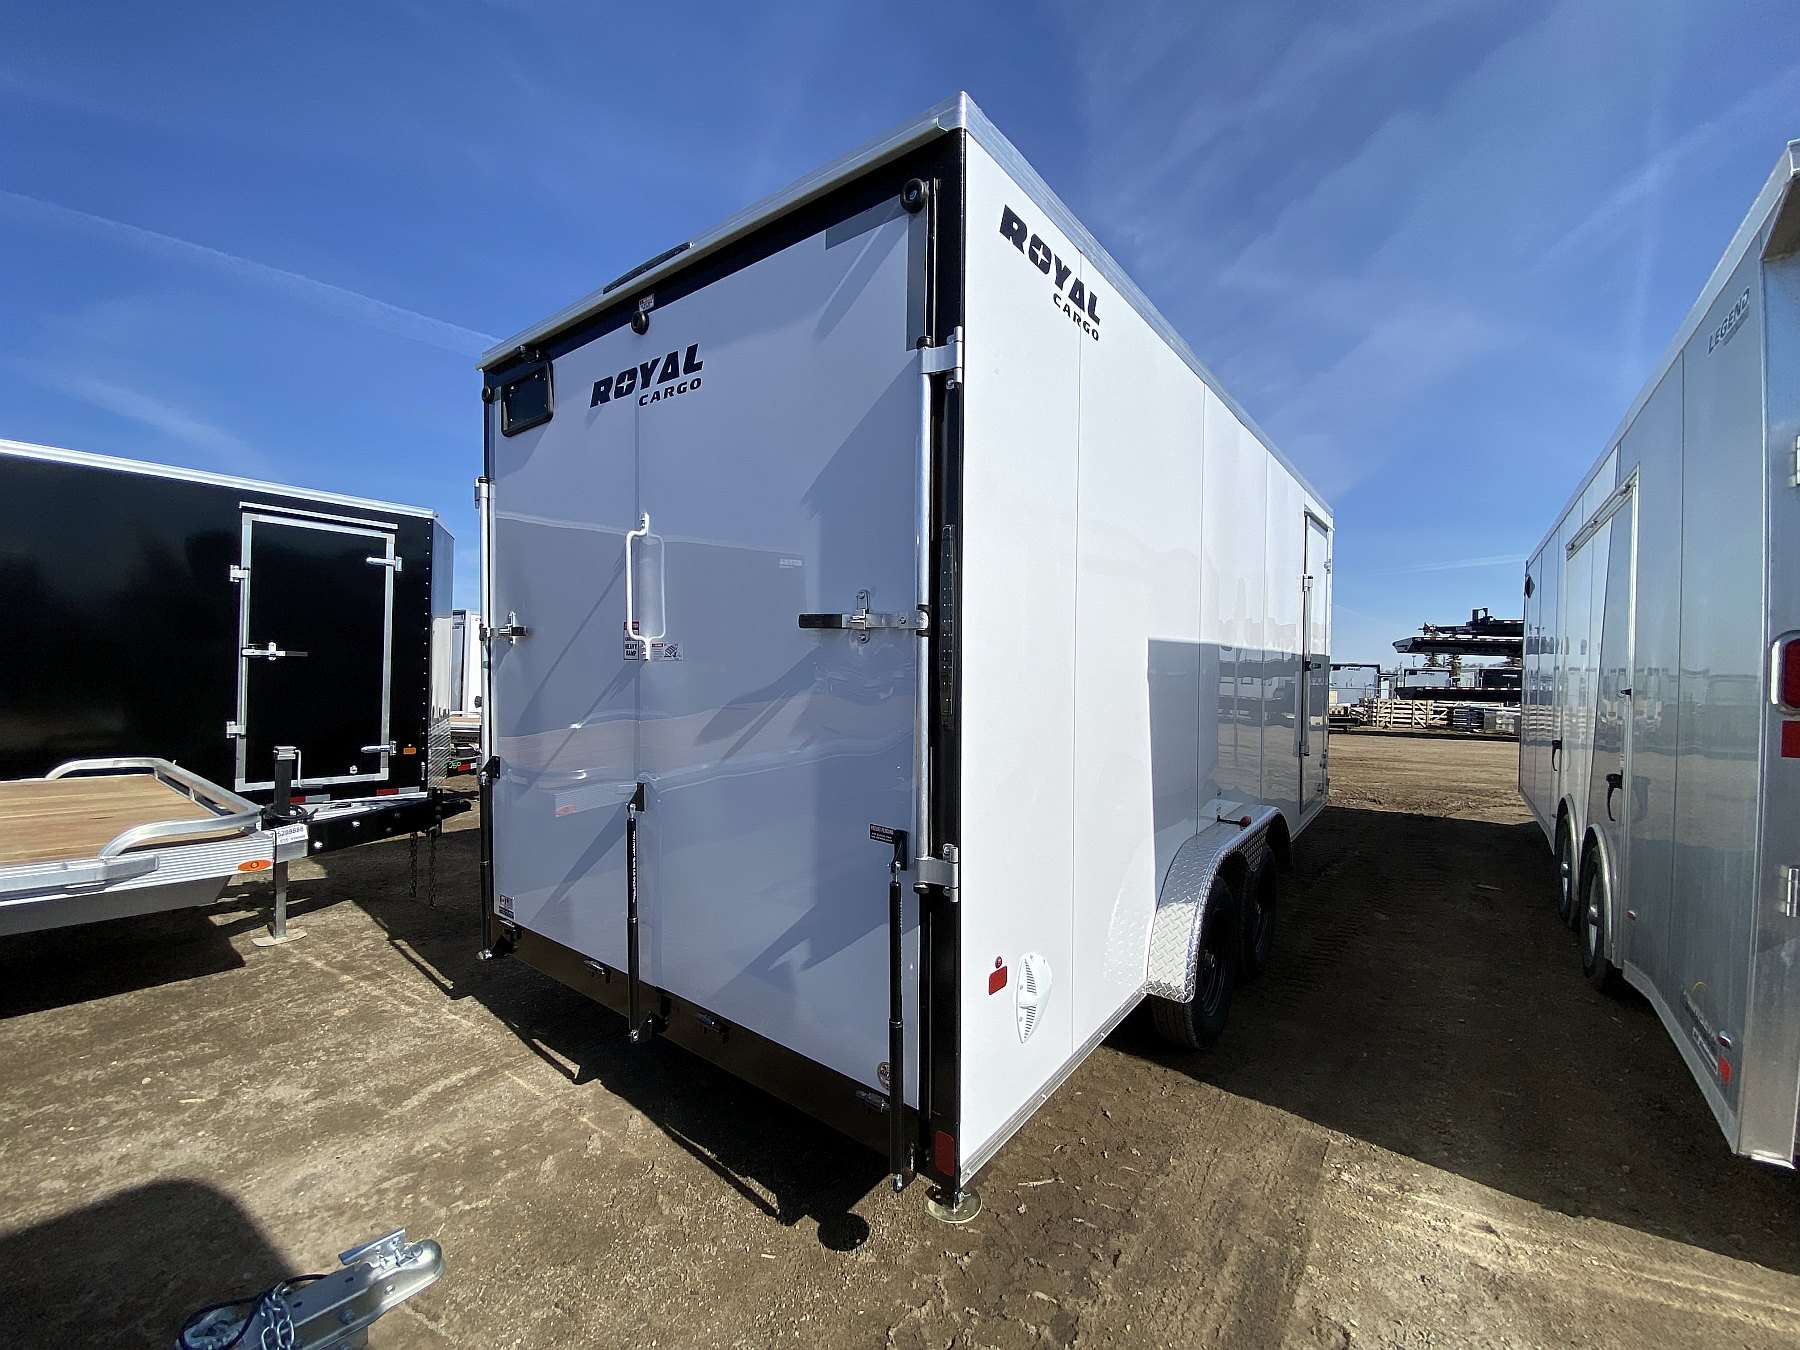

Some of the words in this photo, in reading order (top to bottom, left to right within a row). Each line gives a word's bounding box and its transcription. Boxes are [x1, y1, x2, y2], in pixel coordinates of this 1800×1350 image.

[999, 204, 1101, 326] ROYAL
[1053, 293, 1099, 341] CARGO
[1708, 287, 1749, 354] LEGEND
[590, 344, 703, 408] ROYAL
[638, 377, 702, 406] CARGO
